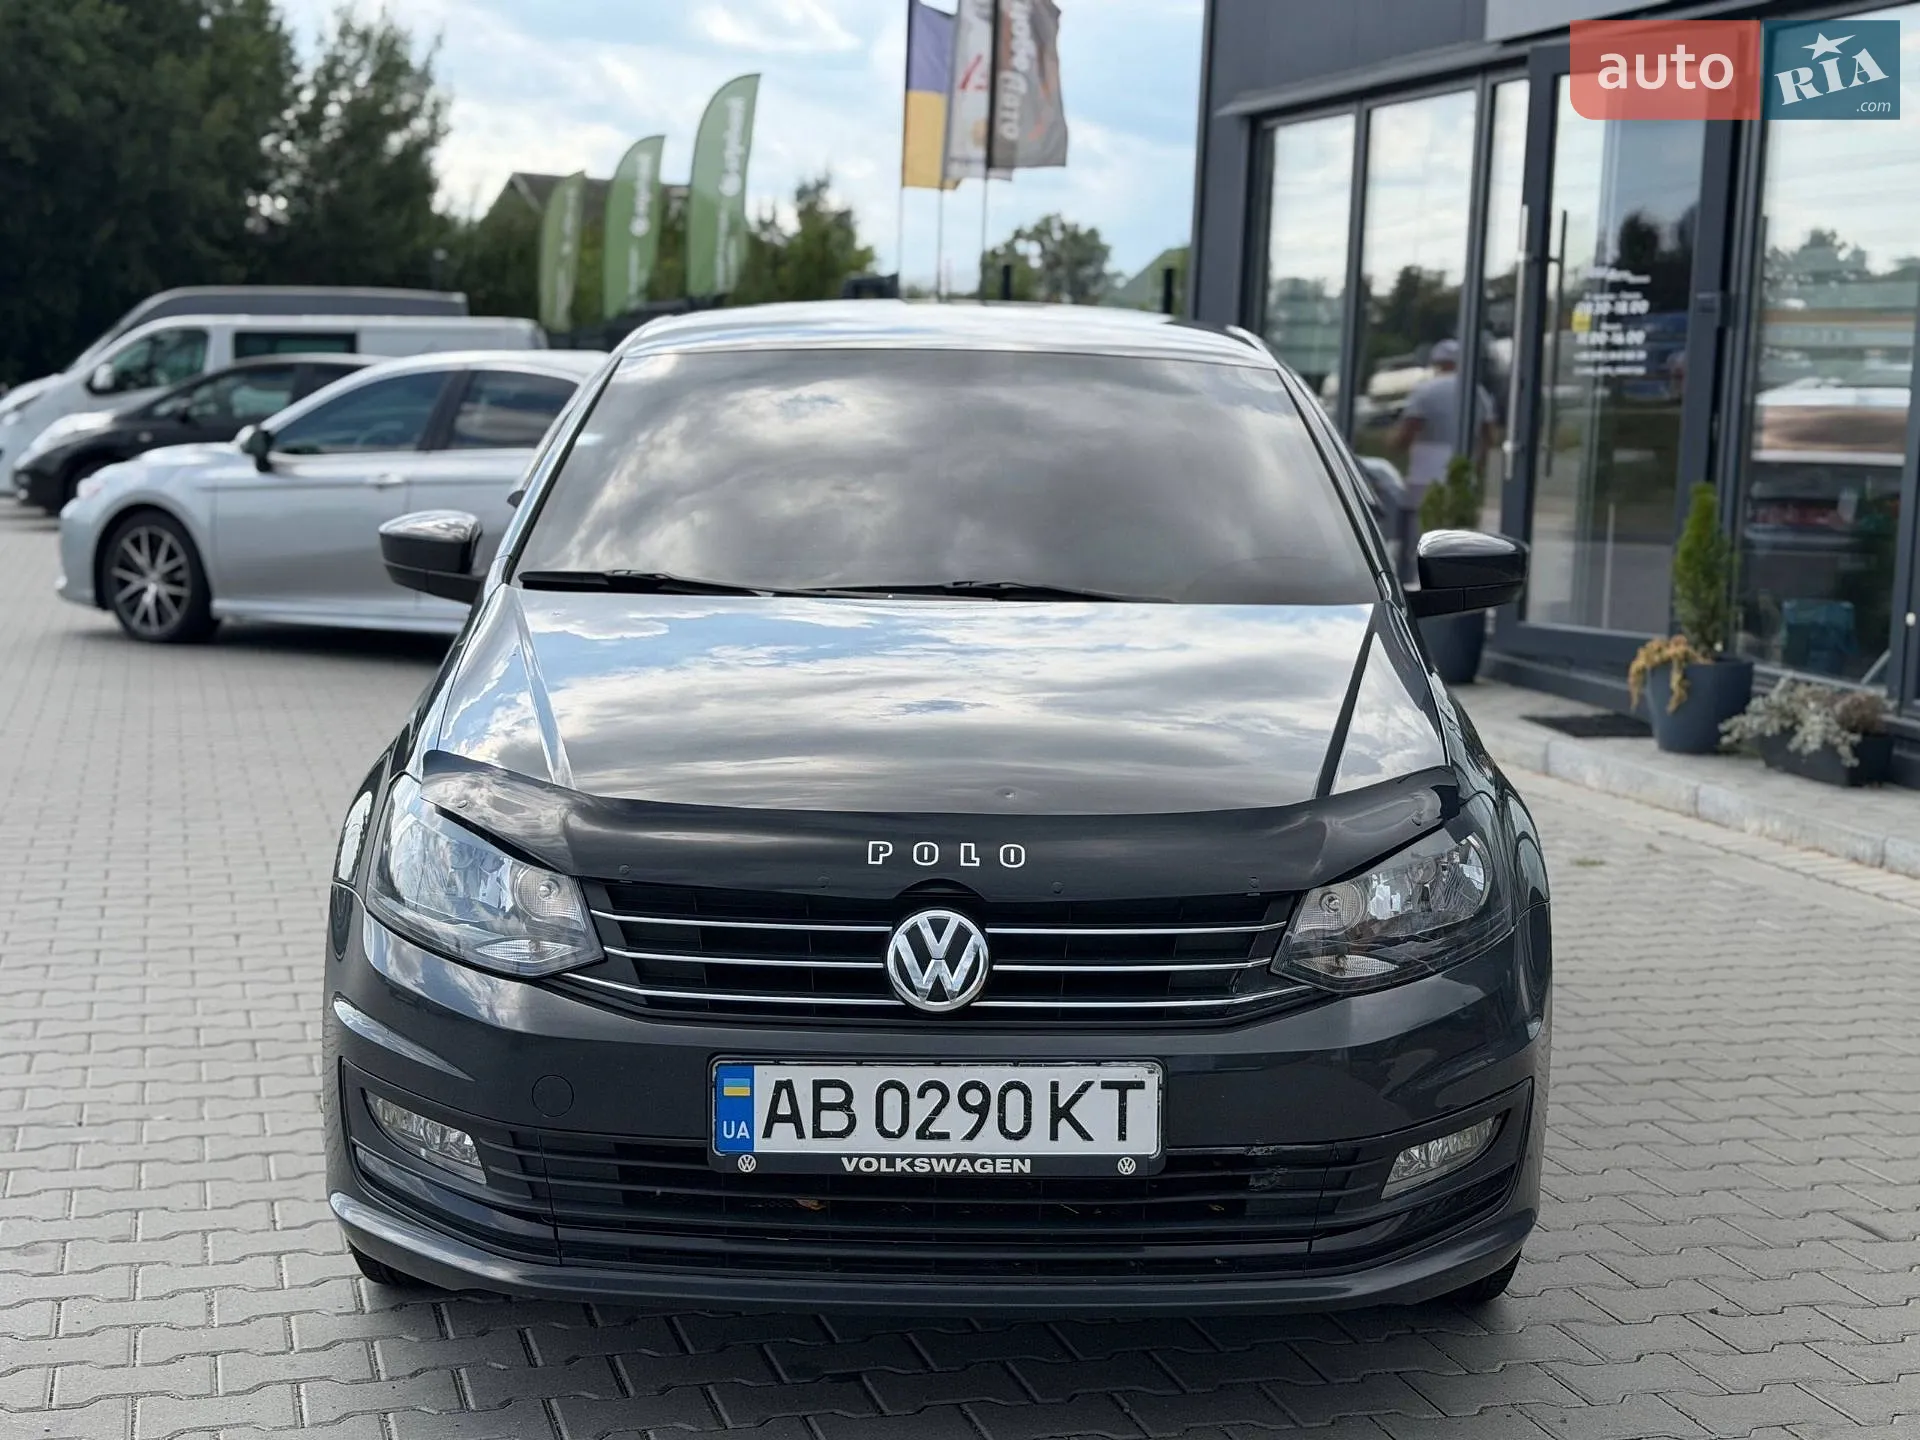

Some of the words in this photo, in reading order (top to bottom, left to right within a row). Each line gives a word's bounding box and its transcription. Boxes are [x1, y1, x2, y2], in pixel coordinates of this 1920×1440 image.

[867, 840, 1026, 869] POLO
[761, 1078, 858, 1140] AB
[874, 1079, 1033, 1141] 0290
[1048, 1080, 1146, 1142] KT
[722, 1121, 750, 1140] UA
[841, 1156, 1031, 1174] VOLKSWAGEN
